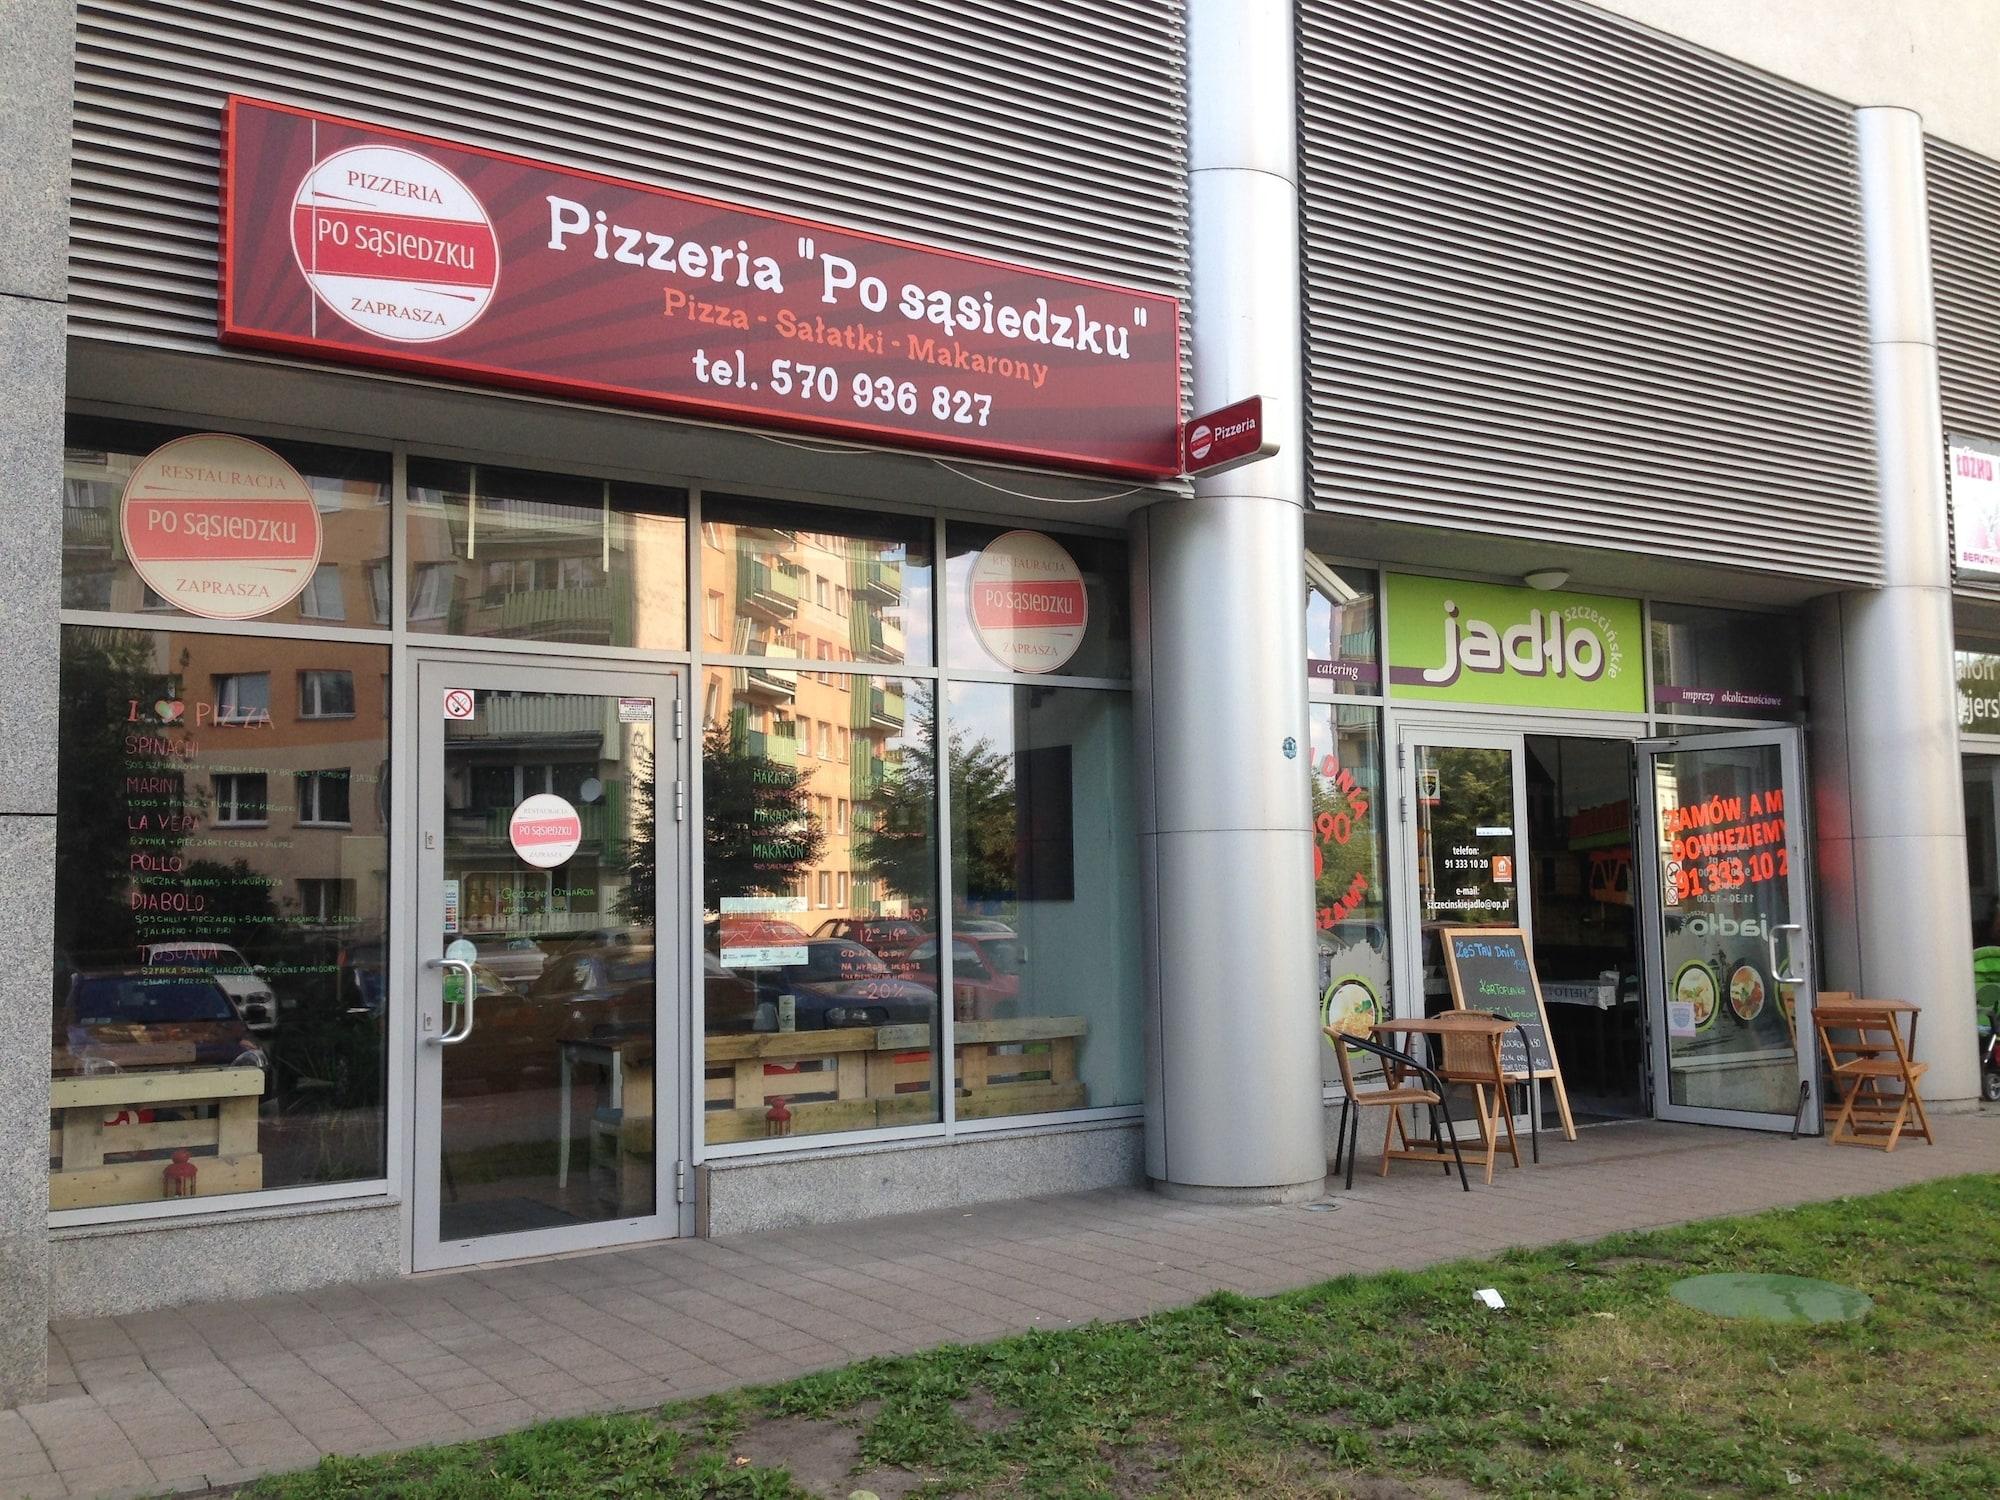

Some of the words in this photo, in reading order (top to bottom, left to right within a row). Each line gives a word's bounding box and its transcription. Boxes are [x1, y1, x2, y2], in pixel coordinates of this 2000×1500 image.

[347, 170, 443, 205] PIZZERIA
[318, 218, 349, 246] PO
[546, 195, 784, 294] Pizzeria
[798, 237, 887, 312] "Po
[899, 284, 1147, 360] sąsiedzku"
[351, 298, 446, 326] ZAPRASZA
[663, 287, 750, 330] Pizza
[776, 309, 884, 355] Sałatki
[908, 336, 1049, 388] Makarony
[692, 348, 758, 391] tel.
[770, 359, 839, 403] 570
[852, 378, 918, 416] 936
[931, 386, 993, 427] 827
[1214, 418, 1256, 441] Pizzeria
[160, 464, 287, 490] RESTAURACJA
[148, 509, 178, 533] PO
[992, 556, 1067, 573] RESTAURACJA
[175, 578, 270, 598] ZAPRASZA
[985, 589, 1004, 607] PO
[1003, 641, 1059, 657] ZAPRASZA
[1423, 600, 1602, 685] jadło
[1565, 607, 1622, 678] szczecińskie
[1316, 662, 1359, 681] catering
[1682, 689, 1715, 704] imprezy
[196, 702, 276, 729] PIZZA
[125, 736, 199, 758] SPINACHI
[128, 814, 149, 830] LA
[158, 814, 200, 832] VERA
[1668, 795, 1741, 832] ZAMÓW
[1750, 794, 1762, 817] A
[520, 825, 530, 835] PO
[752, 843, 804, 859] MAKARON
[1453, 845, 1480, 856] telefon:
[130, 855, 182, 872] POLLO
[1445, 859, 1454, 869] 91
[1455, 859, 1468, 869] 333
[1469, 859, 1478, 869] 10
[1479, 859, 1488, 869] 20
[1676, 868, 1703, 899] 91
[1707, 858, 1745, 892] 333
[1750, 852, 1773, 883] 10
[1456, 886, 1480, 896] e-mail:
[131, 892, 205, 912] DIABOLO
[858, 982, 904, 999] -20%
